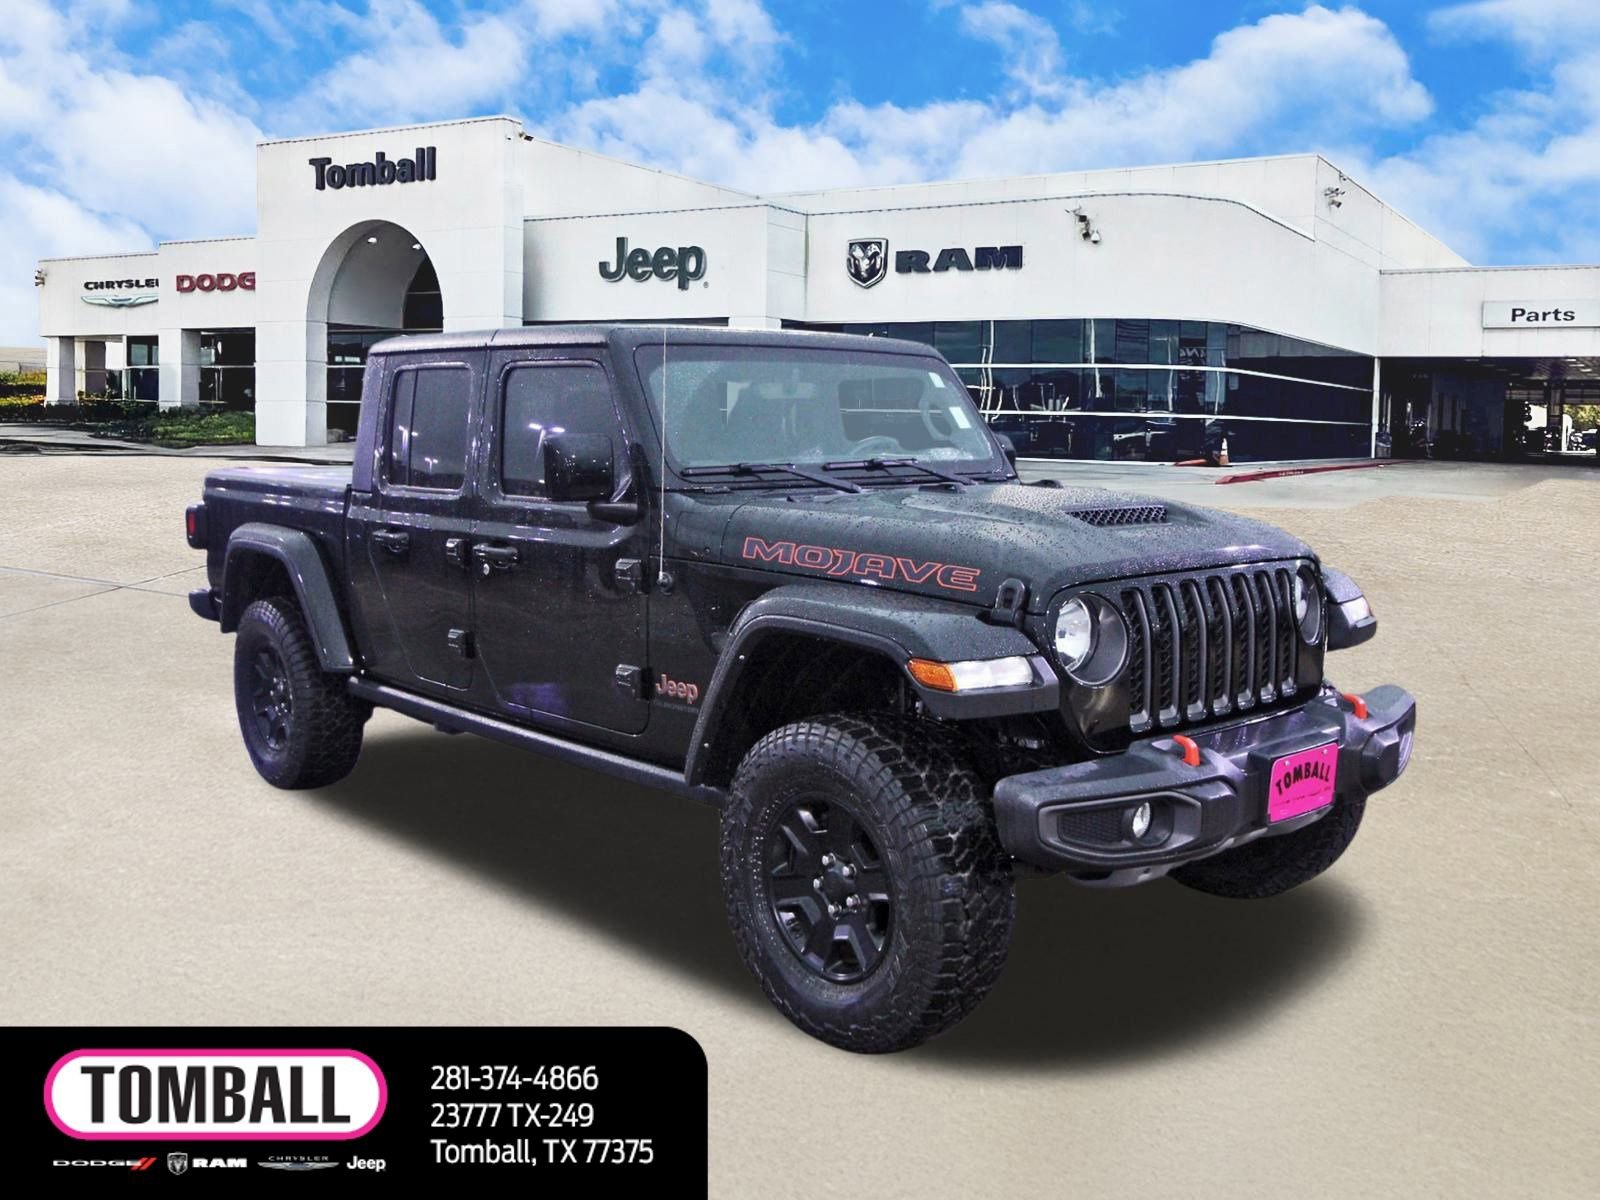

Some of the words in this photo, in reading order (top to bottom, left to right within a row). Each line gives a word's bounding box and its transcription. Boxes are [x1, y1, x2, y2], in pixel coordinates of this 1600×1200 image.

[309, 146, 437, 190] Tomball
[599, 237, 706, 290] Jeep
[896, 245, 1023, 273] RAM
[1511, 307, 1576, 323] Parts
[743, 537, 980, 591] MOJAVE
[655, 673, 699, 705] Jeep
[1276, 762, 1330, 795] TOMBALL
